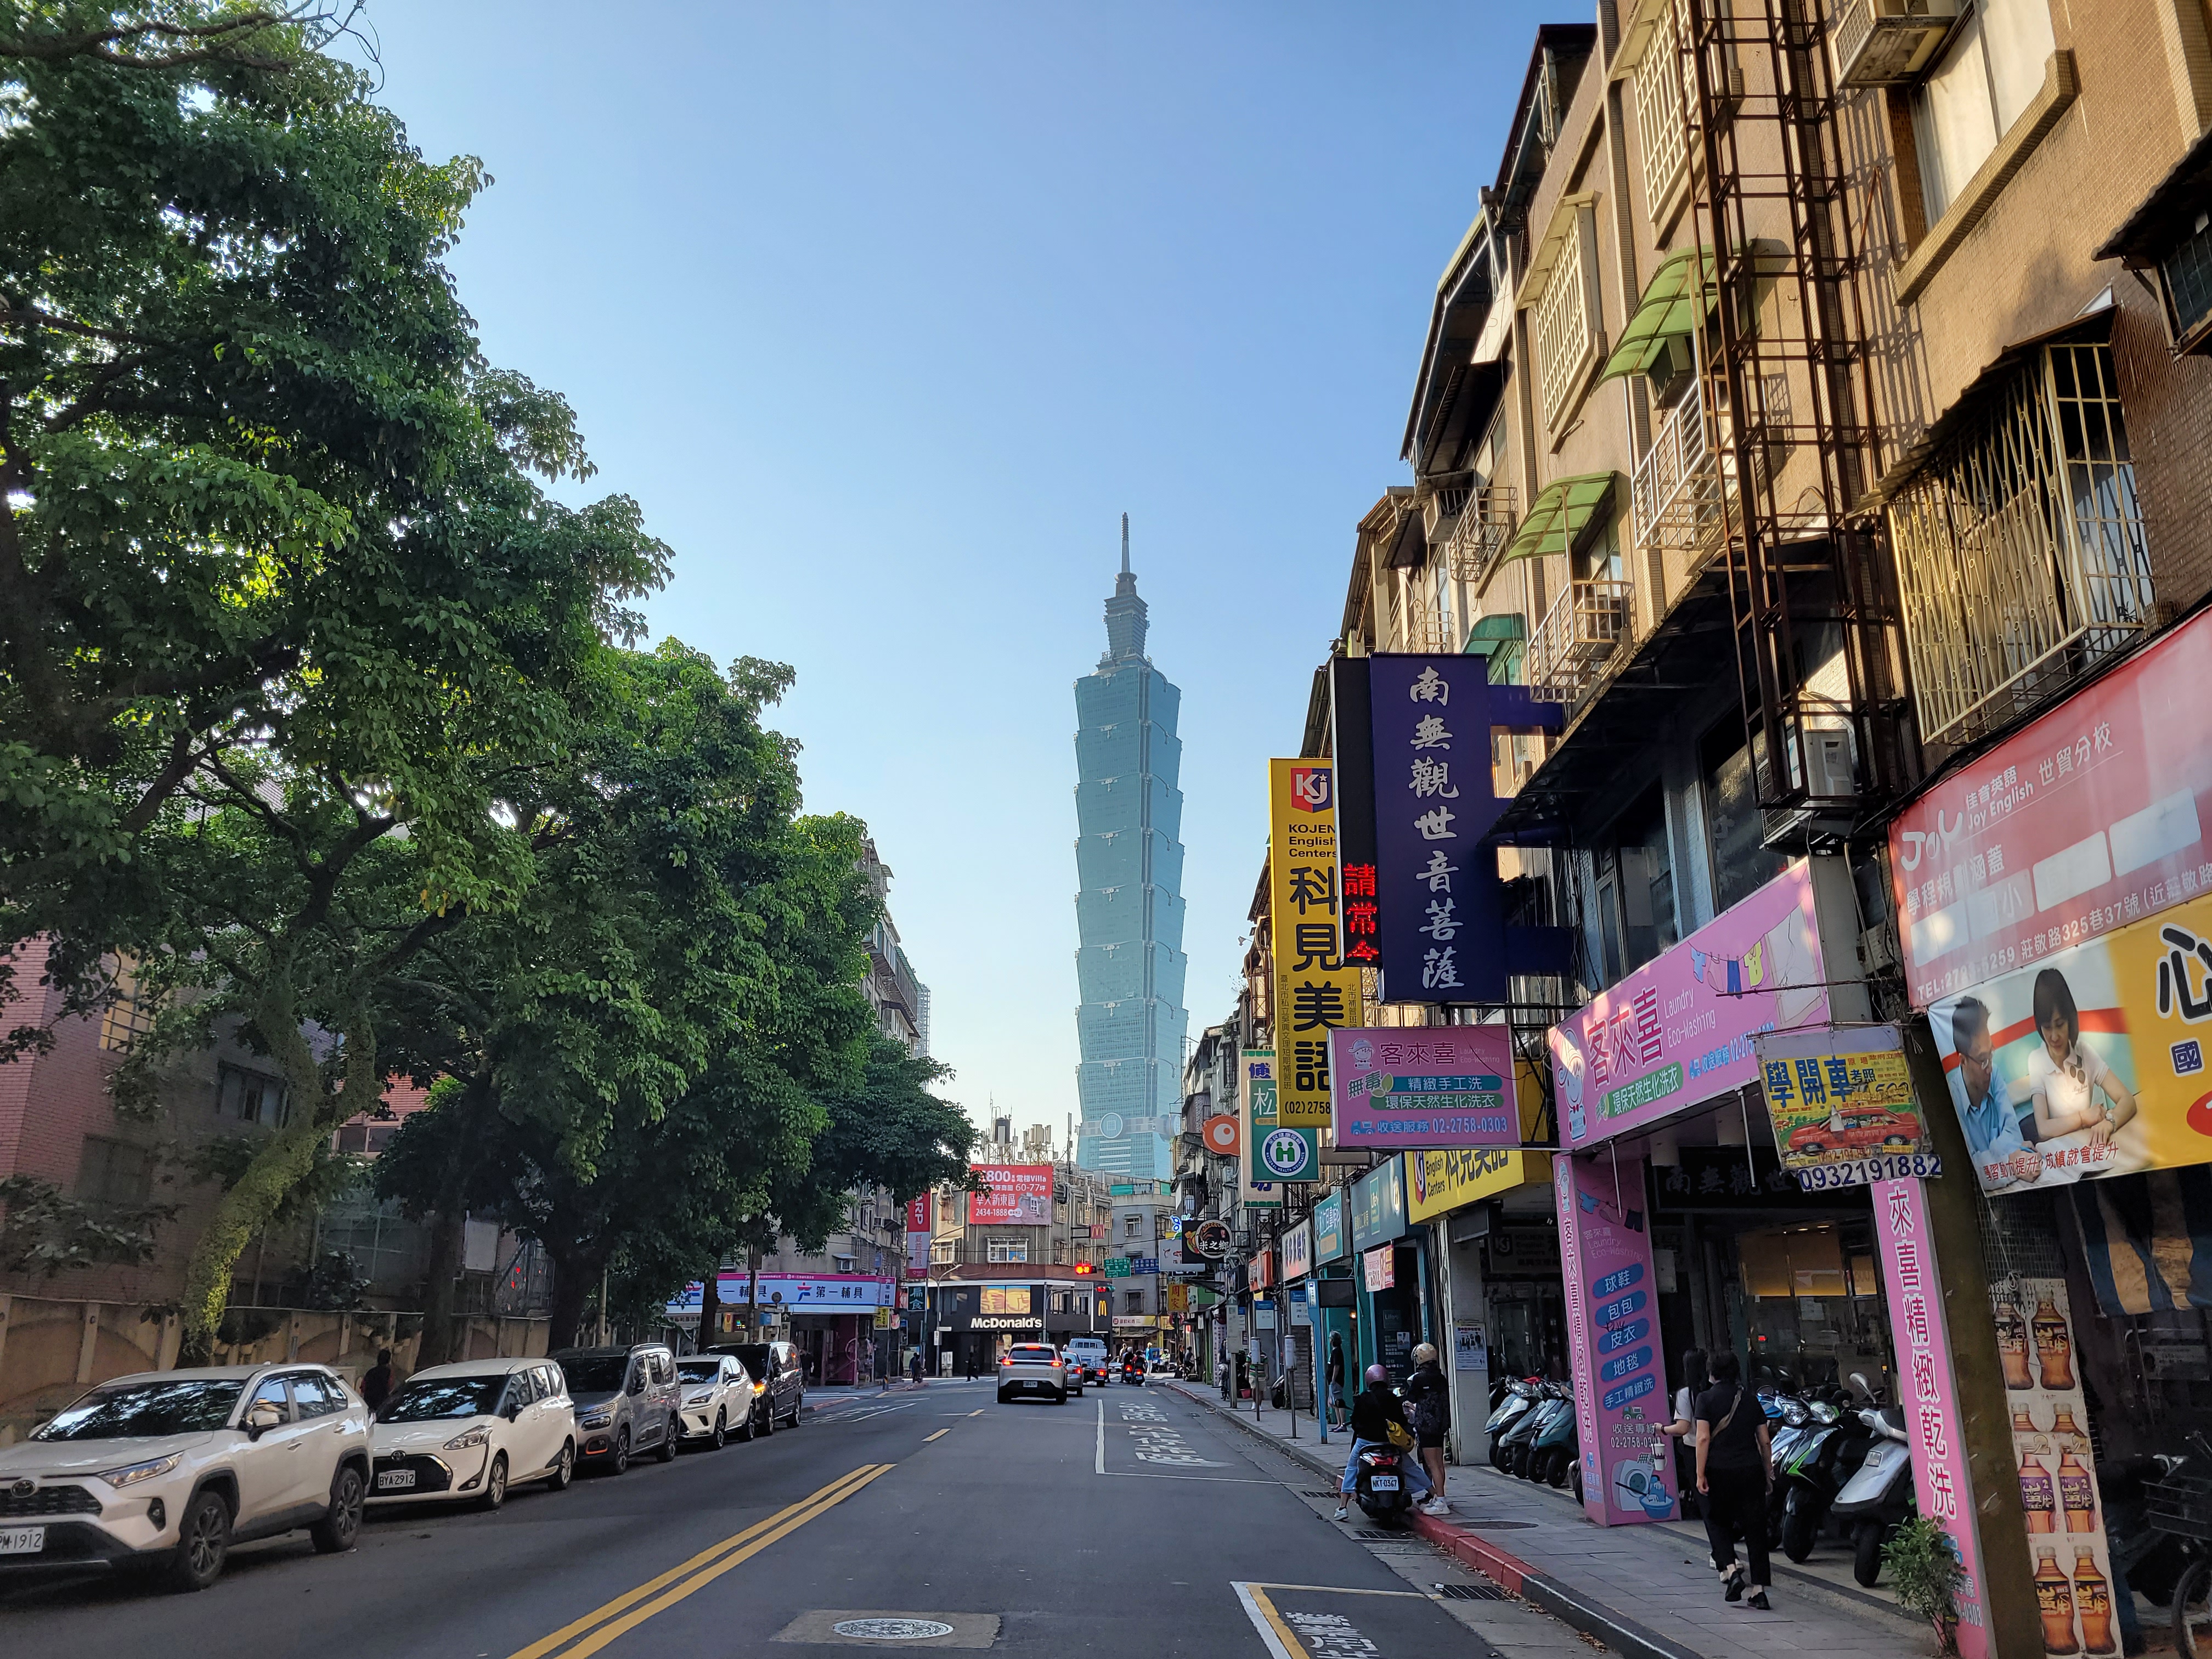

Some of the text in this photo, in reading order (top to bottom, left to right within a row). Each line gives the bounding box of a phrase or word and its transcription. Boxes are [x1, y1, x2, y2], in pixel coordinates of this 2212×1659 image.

[1966, 721, 2113, 810] 佳音英語 世貿分校
[1968, 781, 2034, 830] Joy English
[1289, 825, 1335, 833] KOJEN
[1409, 665, 1466, 990] 南無觀世音菩薩
[1289, 837, 1336, 847] English
[1289, 848, 1337, 857] Centers
[1906, 844, 2005, 916] 學程規劃涵蓋
[1289, 866, 1345, 1091] 科見美語
[1347, 983, 1358, 1028] 北市補習班
[1663, 988, 1694, 1019] Laundry
[1280, 975, 1292, 1089] 臺北市私立吳興文理短期補習班
[1583, 985, 1664, 1091] 客來喜
[1667, 1009, 1716, 1048] Eco-Washing
[1379, 1042, 1457, 1066] 客來喜
[2171, 1041, 2202, 1074] 國
[1348, 1070, 1382, 1101] 無毒
[1408, 1077, 1482, 1091] 精緻手工洗
[1613, 1065, 1679, 1115] 環保天然生化洗衣
[1765, 1056, 1853, 1108] 學開車
[1284, 1101, 1331, 1115] (02)2758
[1385, 1094, 1496, 1110] 環保天然生化洗衣
[1377, 1121, 1430, 1133] 收送服務
[1432, 1117, 1508, 1134] 02-2758-0303
[1426, 1154, 1444, 1177] English
[1799, 1153, 1943, 1191] 0932191882
[1427, 1180, 1445, 1197] Centers
[1199, 1240, 1229, 1251] 米之鄉
[1588, 1238, 1621, 1249] Laundry
[1592, 1246, 1644, 1262] Eco-Washing
[716, 1285, 863, 1299] 一輔具 第一輔具
[1605, 1270, 1630, 1293] 球鞋
[910, 1287, 923, 1310] 扁食
[1607, 1298, 1633, 1321] 包包
[970, 1317, 1042, 1330] McDonald's
[1562, 1218, 1593, 1443] 客來喜精緻乾洗
[1611, 1325, 1636, 1349] 皮衣
[1887, 1179, 1957, 1520] 來喜精緻乾洗
[1613, 1353, 1639, 1376] 地毯
[1605, 1378, 1654, 1408] 手工精緻洗
[1613, 1423, 1655, 1434] 收送專線
[379, 1473, 415, 1486] BYA-2912
[1372, 1480, 1398, 1488] NKT-0367
